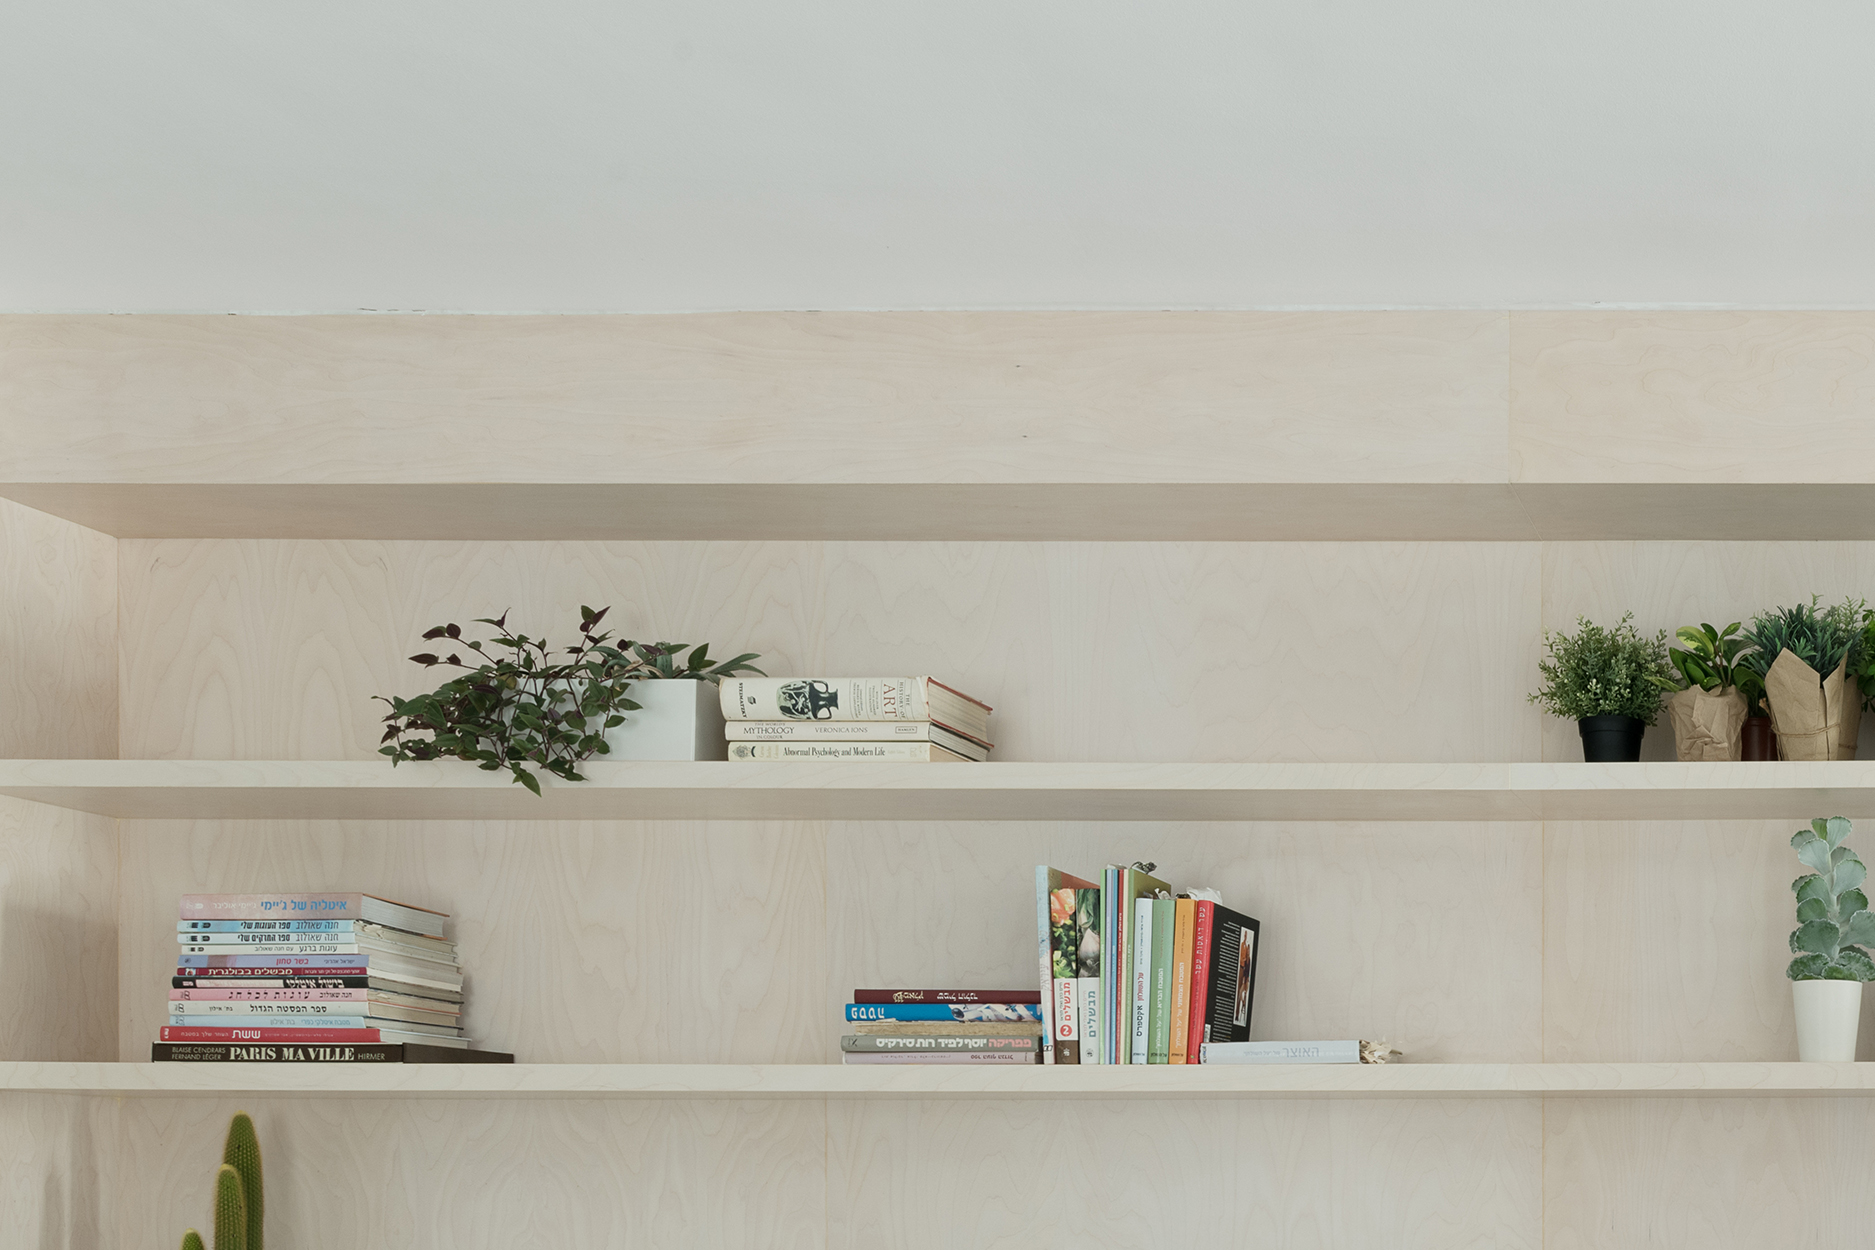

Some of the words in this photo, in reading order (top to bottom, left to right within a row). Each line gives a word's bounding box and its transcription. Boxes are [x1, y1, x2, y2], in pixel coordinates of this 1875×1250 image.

[883, 683, 898, 718] ART
[743, 726, 795, 735] MYTHOLOGY
[851, 1007, 885, 1019] פסטה
[229, 1047, 276, 1060] PARIS
[282, 1047, 307, 1060] MA
[307, 1047, 355, 1060] VILLE
